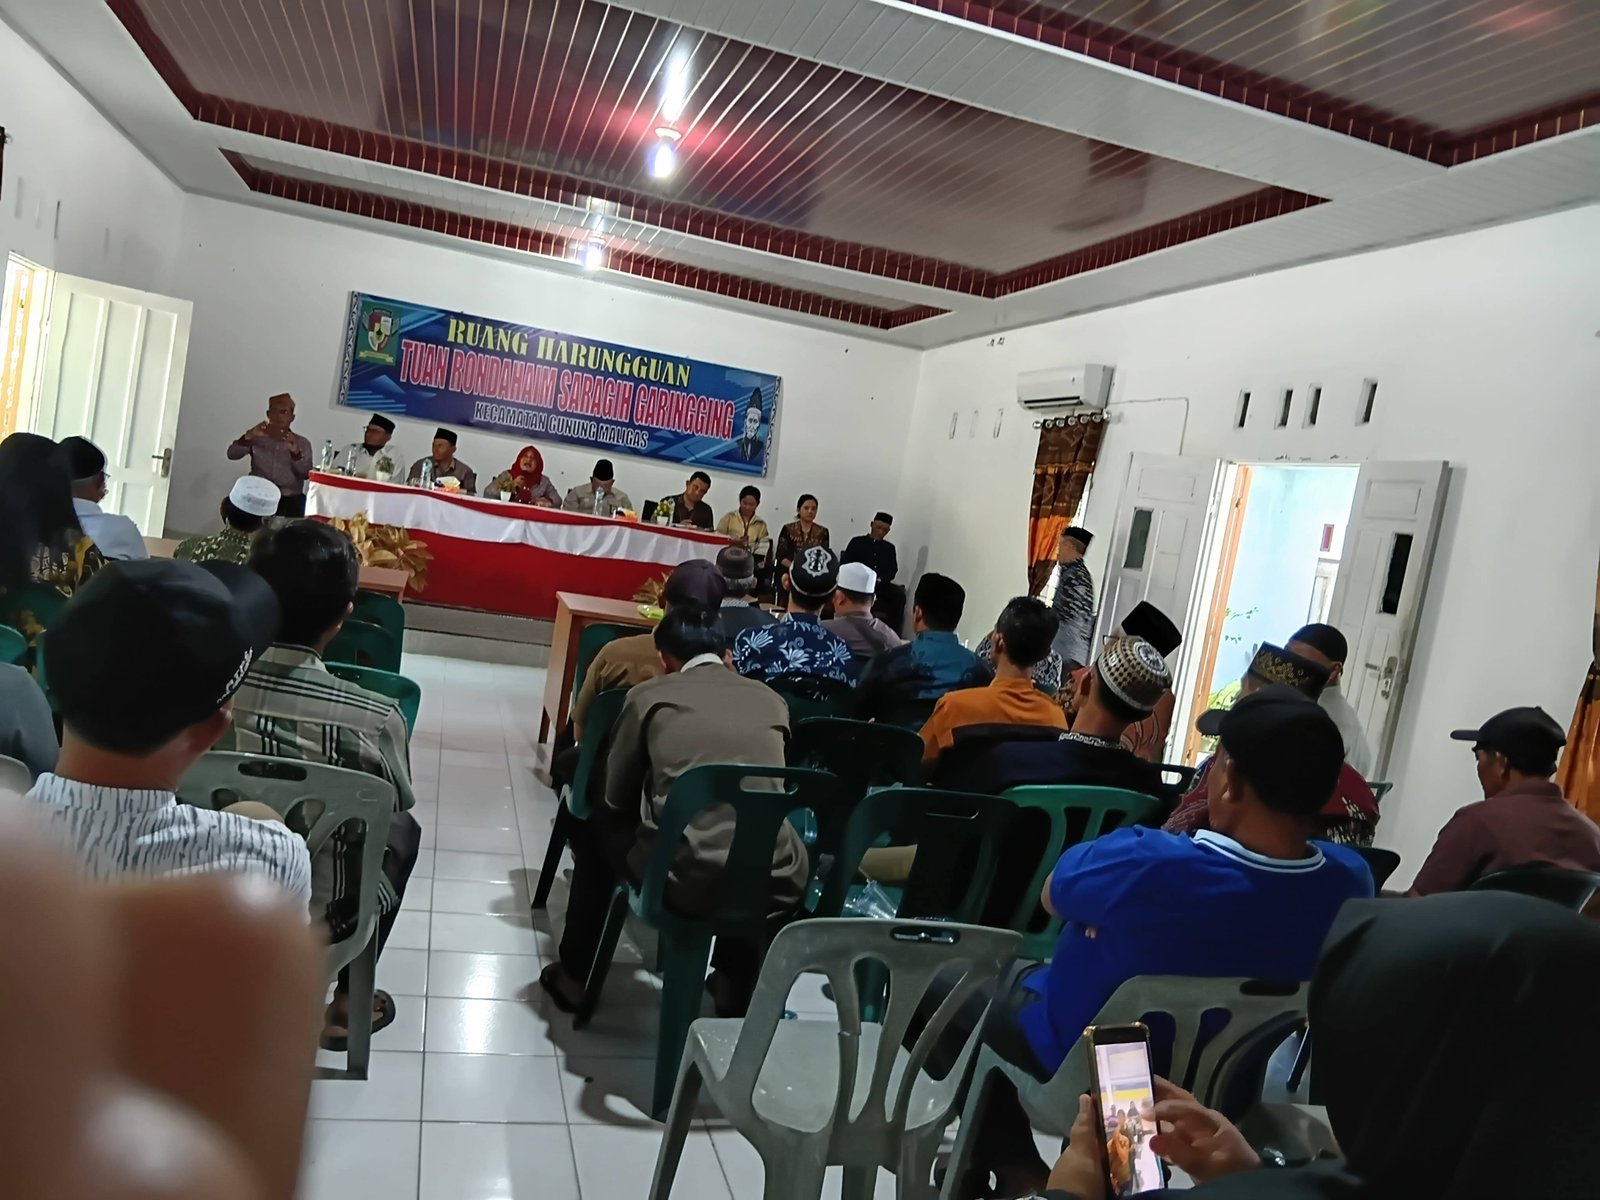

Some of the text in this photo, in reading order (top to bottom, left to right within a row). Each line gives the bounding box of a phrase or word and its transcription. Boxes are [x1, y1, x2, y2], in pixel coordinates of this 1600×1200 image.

[447, 319, 691, 387] RUANG HARUNGGUAN
[400, 339, 735, 439] TUAN RONDAHAIM SARAGIH GARINGGING
[474, 401, 649, 449] KECAMATAN GUNUNG MALIGAS
